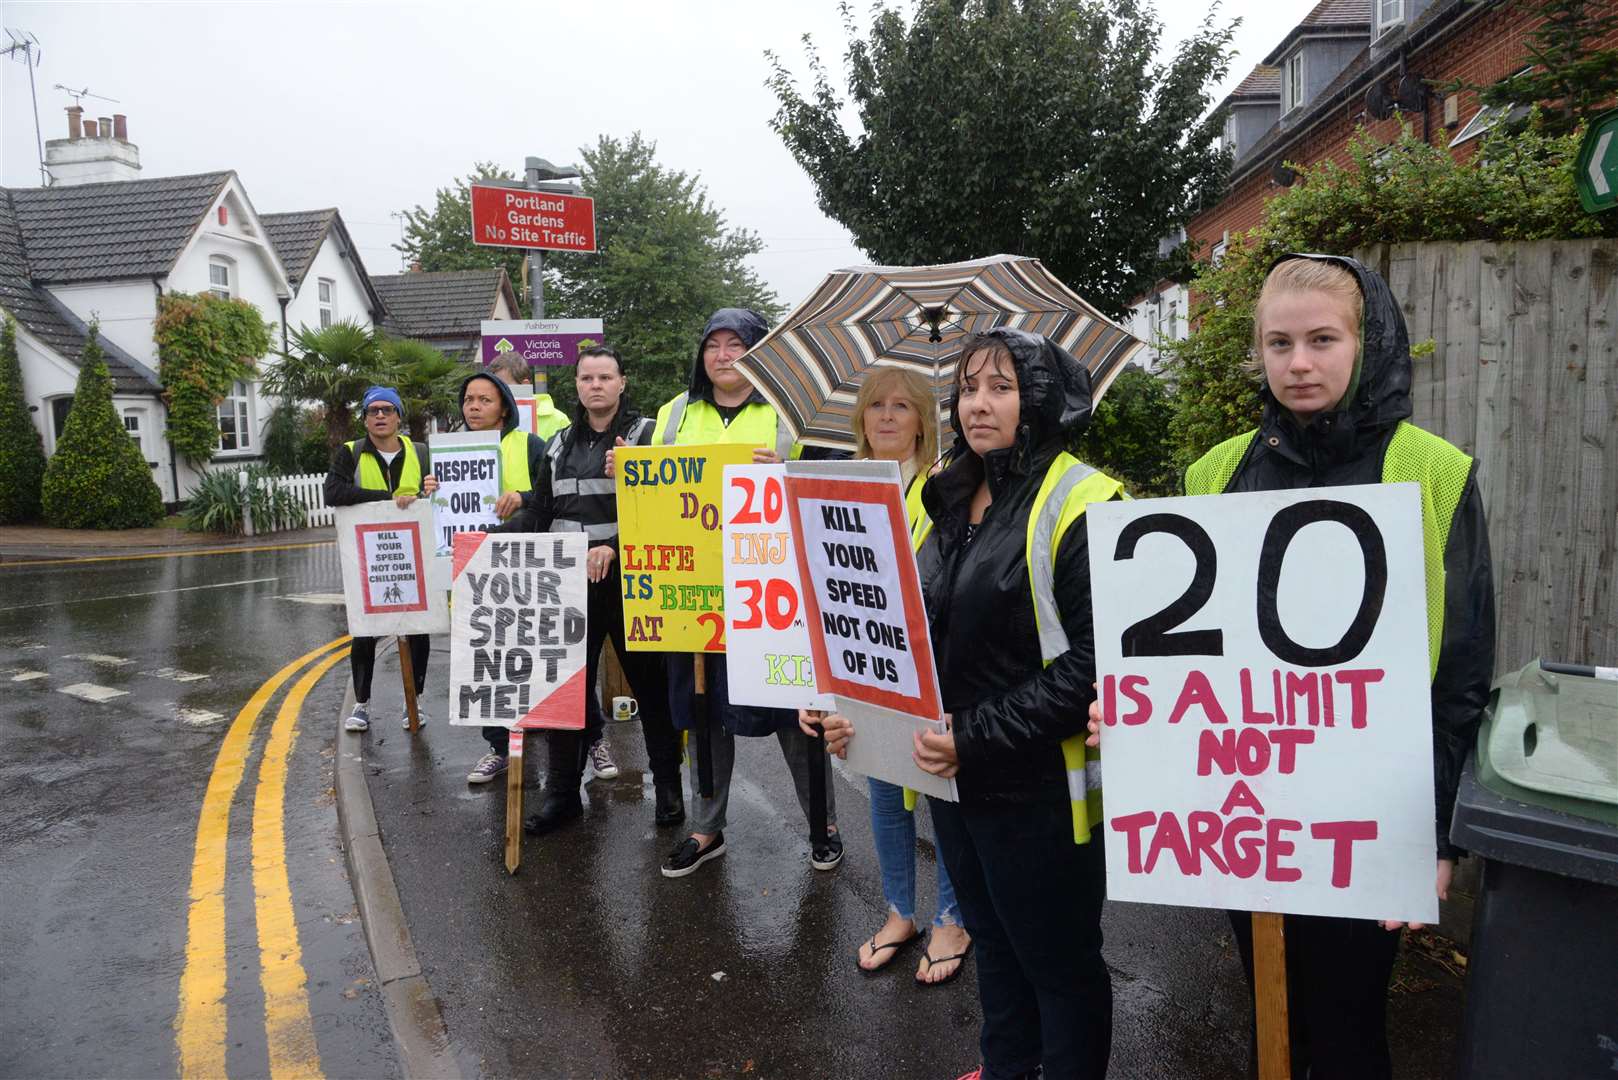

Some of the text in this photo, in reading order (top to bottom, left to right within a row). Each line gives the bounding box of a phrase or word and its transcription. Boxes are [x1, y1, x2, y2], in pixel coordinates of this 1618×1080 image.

[506, 193, 564, 212] Portland
[508, 211, 564, 228] Gardens
[485, 225, 586, 246] No Site Traffic
[524, 350, 563, 359] Gardens
[525, 340, 560, 349] Victoria
[434, 459, 495, 482] RESPECT
[624, 457, 706, 487] SLOW
[450, 492, 481, 514] OUR
[729, 476, 783, 524] 20
[821, 505, 866, 534] KILL
[377, 532, 399, 540] KILL
[731, 532, 789, 565] INJ
[371, 563, 412, 572] NOT OUR
[376, 553, 405, 561] SPEED
[491, 540, 576, 569] KILL
[624, 545, 694, 571] LIFE
[822, 542, 878, 573] YOUR
[369, 574, 415, 582] CHILDREN
[467, 570, 562, 605] YOUR
[623, 574, 654, 600] IS
[1113, 499, 1388, 667] 20
[732, 578, 798, 630] 30
[826, 578, 887, 610] SPEED
[469, 606, 586, 647] SPEED
[627, 615, 663, 641] AT
[822, 612, 907, 651] NOT ONE
[473, 648, 567, 684] NOT
[842, 650, 899, 683] OF US
[459, 684, 530, 719] ME!
[1103, 667, 1385, 729] IS A LIMIT
[1197, 727, 1315, 776] NOT
[1220, 780, 1265, 815] A
[1110, 810, 1378, 889] TARGET
